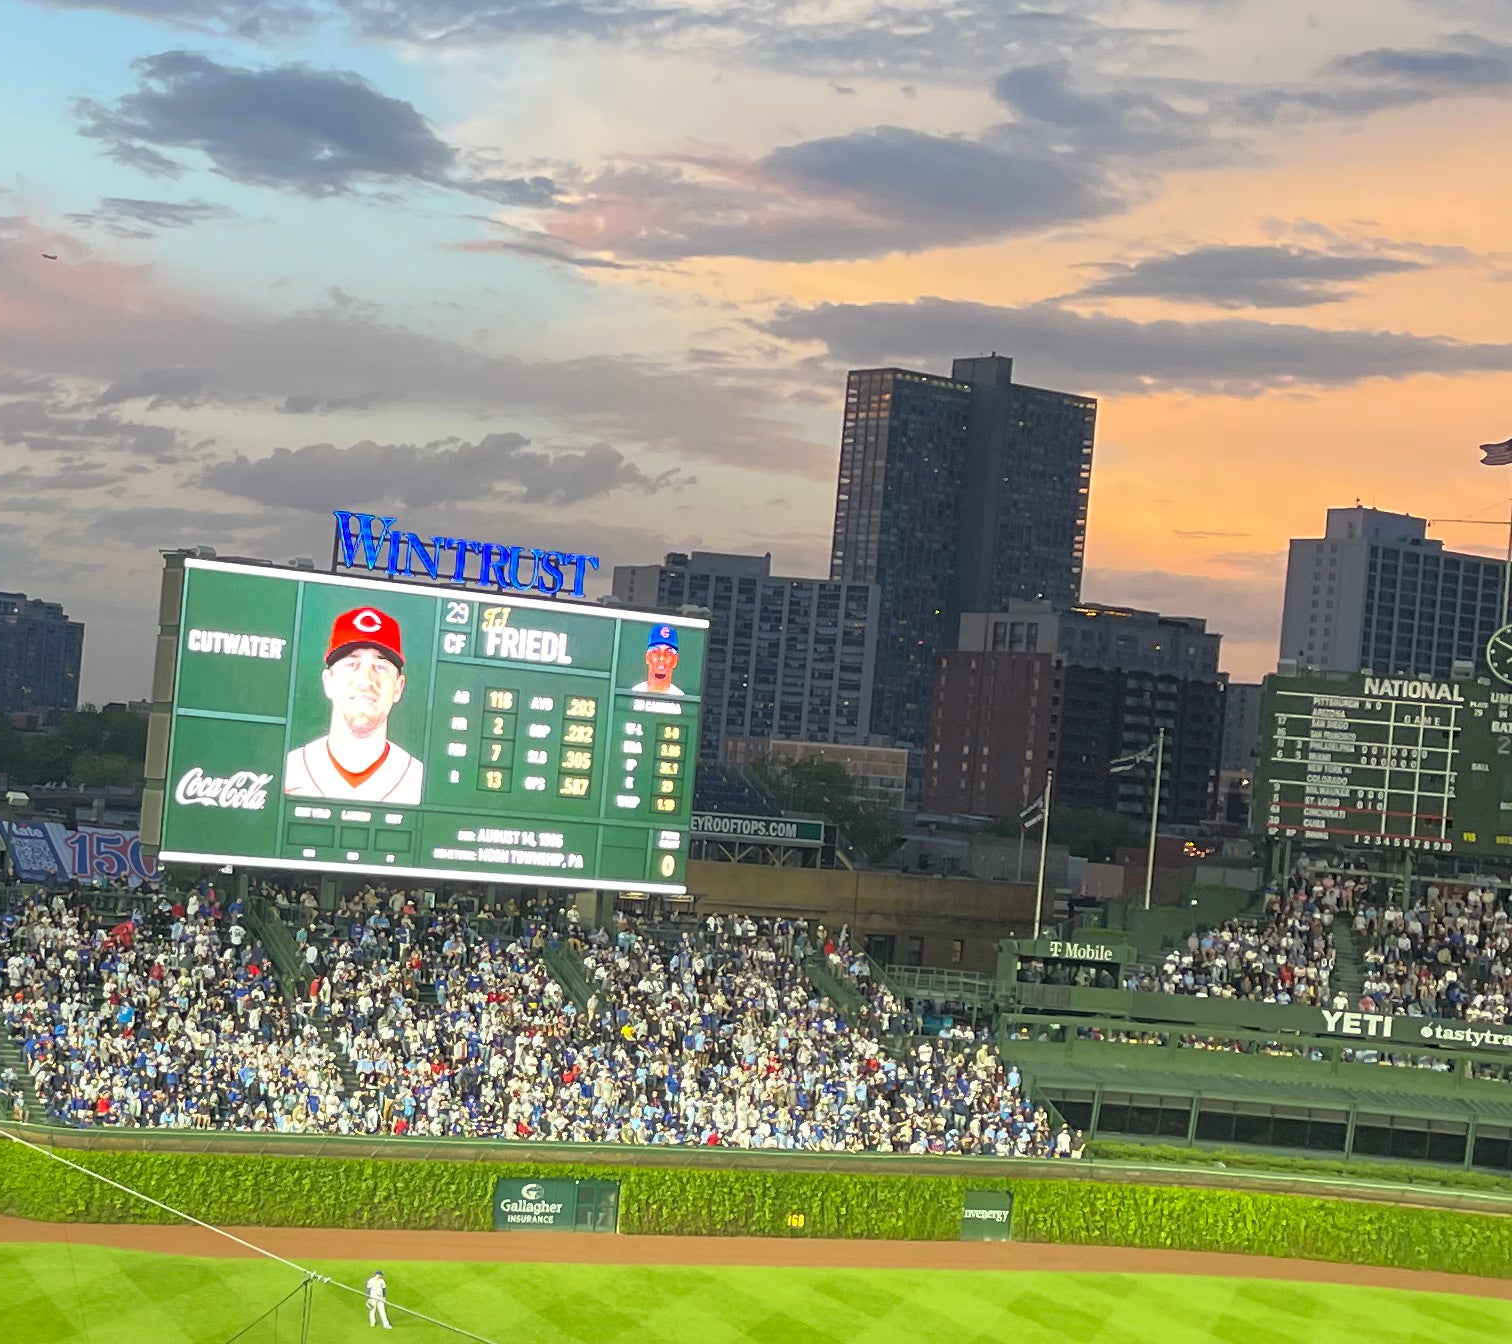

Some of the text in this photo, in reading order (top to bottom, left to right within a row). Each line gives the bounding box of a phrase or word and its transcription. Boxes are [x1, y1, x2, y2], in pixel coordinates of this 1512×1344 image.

[334, 511, 600, 598] WINTRUST
[446, 602, 469, 624] 29
[188, 629, 285, 659] CUTWATER
[444, 633, 467, 654] CF
[486, 628, 572, 664] FRIEDL
[1364, 678, 1465, 702] NATIONAL
[493, 717, 504, 735] 2
[491, 744, 502, 761] 7
[561, 751, 591, 769] .305
[175, 767, 273, 810] Coca-Cola
[486, 770, 502, 789] 13
[690, 815, 797, 838] EYROOFTOPS.COM
[1354, 834, 1453, 851] 1 2 3 4 5 6 7 8 9 10
[662, 855, 675, 877] 0
[1065, 942, 1113, 961] Mobile
[1321, 1009, 1393, 1038] YETI
[500, 1199, 563, 1215] Gallagher
[962, 1209, 1009, 1223] nvenergy
[508, 1215, 555, 1224] INSURANCE
